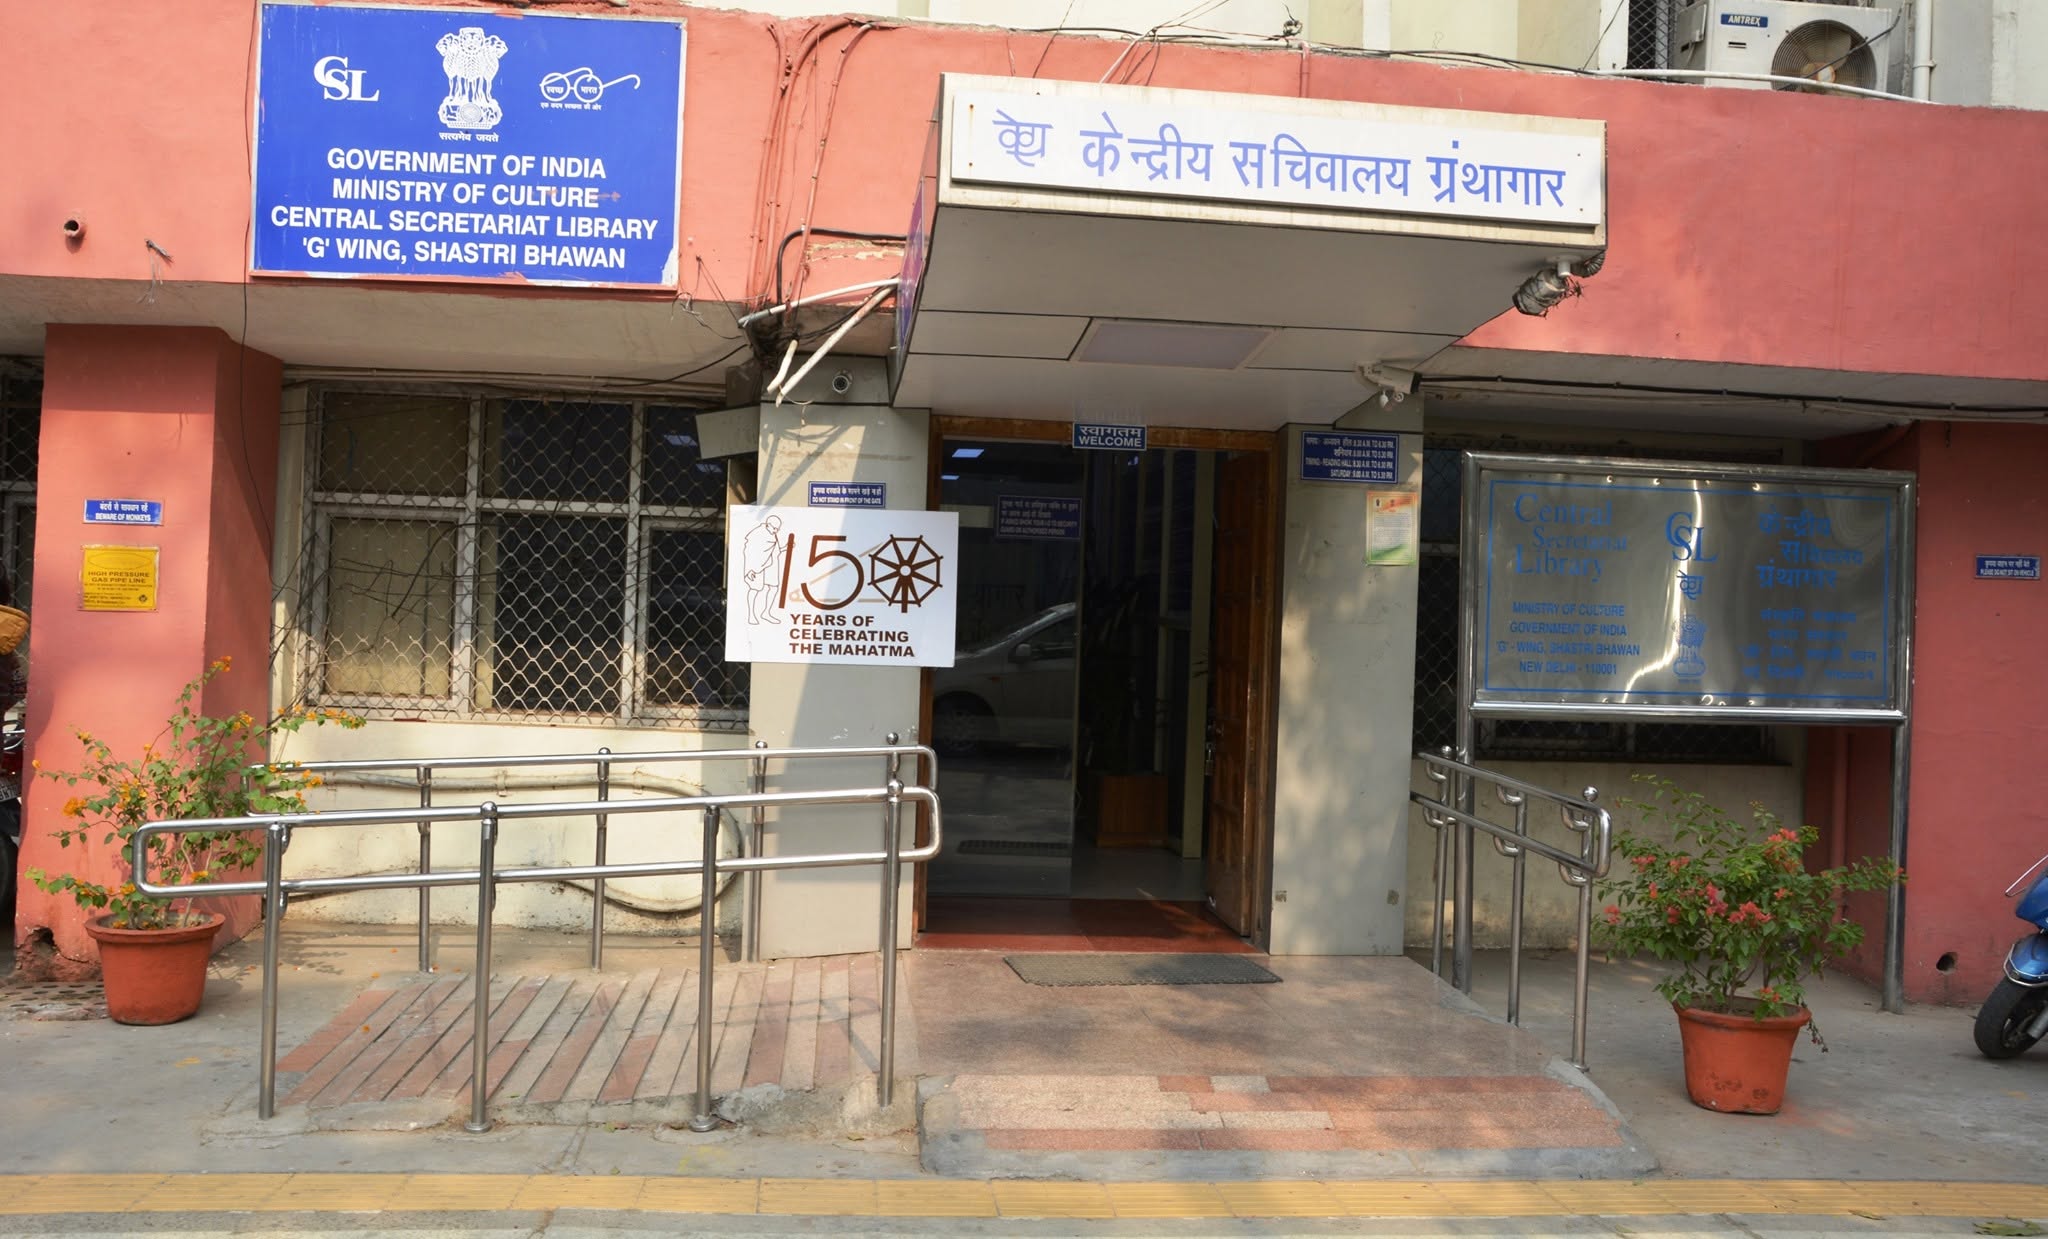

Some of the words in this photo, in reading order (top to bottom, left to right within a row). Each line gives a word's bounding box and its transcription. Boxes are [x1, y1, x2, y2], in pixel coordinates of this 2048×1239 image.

[1728, 15, 1761, 27] AMTREX
[581, 86, 598, 95] भारत
[438, 131, 472, 142] सत्यमेव
[475, 132, 499, 143] जयते
[327, 148, 497, 177] GOVERNMENT
[502, 155, 534, 178] OF
[542, 157, 606, 180] INDIA
[1080, 111, 1214, 182] केन्द्रीय
[1230, 133, 1410, 197] सचिवालय
[1426, 140, 1566, 208] ग्रंथागार
[332, 178, 449, 204] MINISTRY
[453, 183, 483, 204] OF
[488, 184, 600, 209] CULTURE
[271, 206, 383, 231] CENTRAL
[389, 210, 550, 236] SECRETARIAT
[556, 217, 658, 240] LIBRARY
[303, 237, 330, 258] 'G'
[336, 239, 407, 265] WING,
[414, 241, 516, 266] SHASTRI
[524, 246, 625, 269] BHAWAN
[1078, 435, 1142, 447] WELCOME
[1322, 458, 1341, 467] READING
[1341, 459, 1353, 467] HALL
[1513, 493, 1612, 526] Central
[1758, 504, 1831, 538] केन्द्रीय
[1532, 526, 1627, 551] Secretariat
[1515, 544, 1605, 583] Library
[1755, 558, 1838, 590] ग्रंथागार
[1512, 602, 1559, 615] MINISTRY
[1562, 603, 1576, 616] OF
[1578, 604, 1626, 617] CULTURE
[790, 614, 847, 626] YEARS
[852, 615, 875, 627] OF
[789, 629, 909, 642] CELEBRATING
[1509, 622, 1581, 635] GOVERNMENT
[1583, 623, 1598, 636] OF
[1600, 624, 1627, 637] INDIA
[789, 643, 823, 655] THE
[828, 644, 915, 657] MAHATMA
[1550, 643, 1594, 655] SHASTRI
[1596, 644, 1640, 656] BHAWAN
[1519, 661, 1542, 673] NEW
[1545, 662, 1576, 673] DELHI
